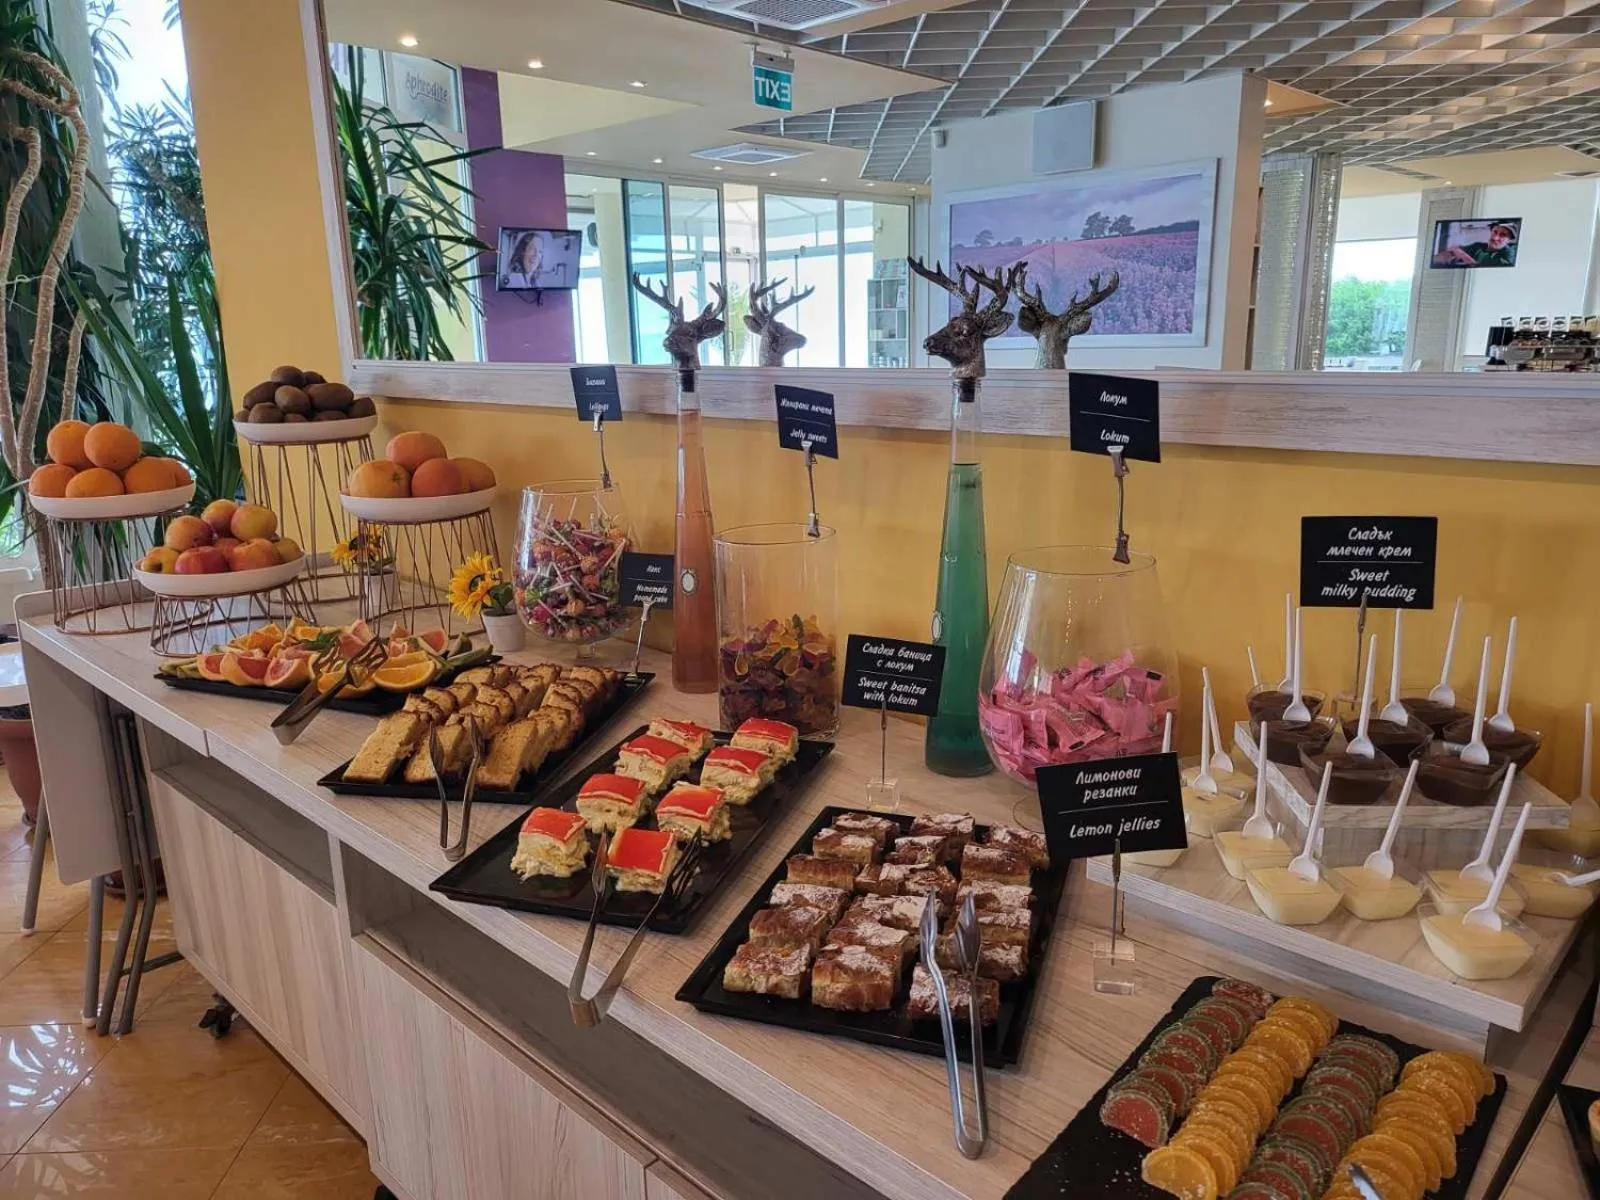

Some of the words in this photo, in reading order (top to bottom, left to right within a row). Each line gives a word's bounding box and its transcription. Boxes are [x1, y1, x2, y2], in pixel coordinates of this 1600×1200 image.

[1100, 390, 1128, 407] Локум
[790, 428, 806, 441] Jelly
[1100, 428, 1130, 444] Lokum
[1347, 525, 1394, 541] Сладък
[1326, 545, 1375, 557] млечен
[1377, 545, 1413, 559] крем
[1347, 567, 1391, 582] Sweet
[636, 583, 668, 594] Homemade
[1320, 582, 1359, 600] milky
[1362, 583, 1418, 603] pudding
[862, 641, 895, 657] Сладка
[897, 646, 933, 662] баница
[876, 659, 883, 668] с
[884, 660, 915, 673] локум
[857, 676, 889, 691] Sweet
[890, 680, 928, 696] banitsa
[863, 690, 886, 702] with
[887, 693, 919, 707] lokum
[1075, 767, 1142, 785] Лимонови
[1082, 785, 1138, 804] резанки
[1069, 823, 1113, 839] Lemon
[1116, 816, 1162, 837] jellies
